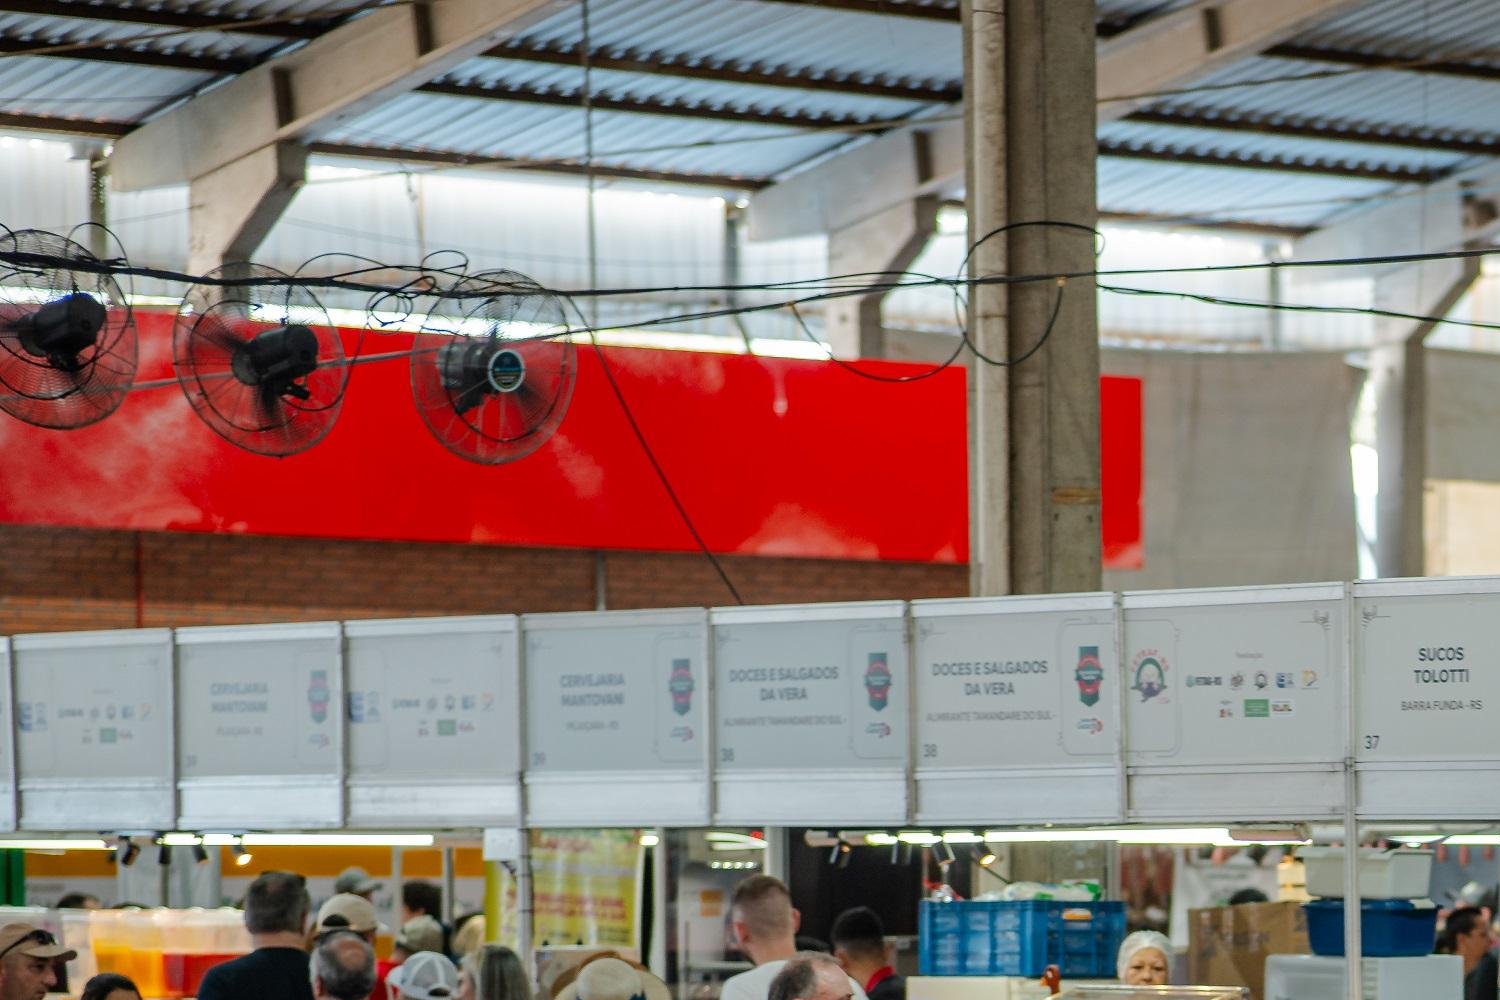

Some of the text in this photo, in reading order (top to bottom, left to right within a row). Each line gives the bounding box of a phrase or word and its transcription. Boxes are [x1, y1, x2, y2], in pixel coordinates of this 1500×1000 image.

[1418, 646, 1464, 661] SUCOS
[729, 666, 839, 682] DOCES E SALGADOS
[932, 660, 1049, 676] DOCES E SALGADOS
[1413, 669, 1469, 684] TOLOTTI
[760, 687, 808, 701] DA VERA
[965, 682, 1015, 696] DA VERA
[1470, 699, 1483, 710] RS
[1365, 735, 1380, 750] 37
[923, 744, 938, 758] 38
